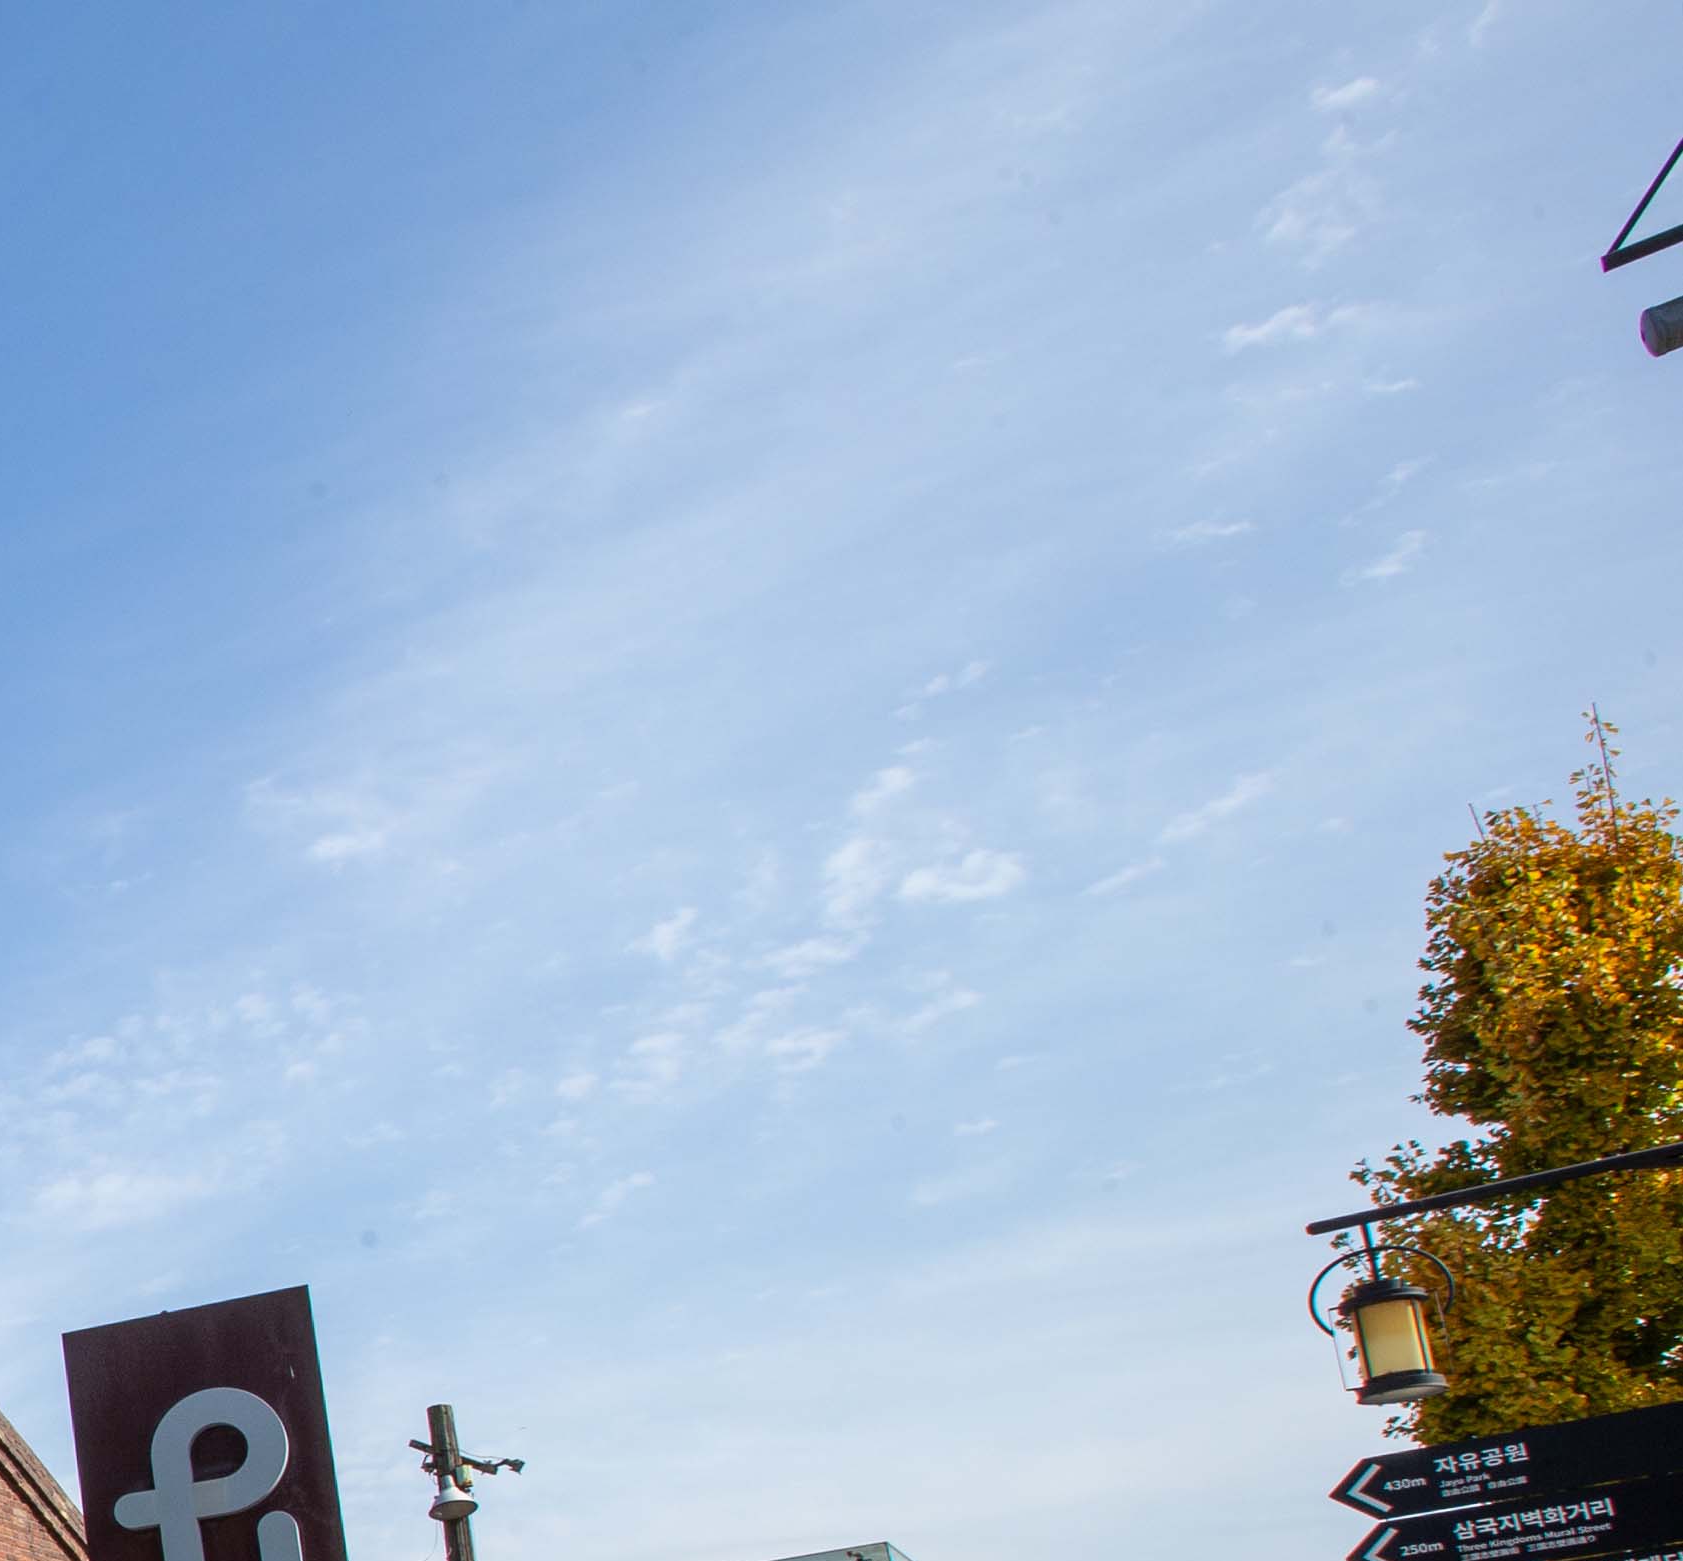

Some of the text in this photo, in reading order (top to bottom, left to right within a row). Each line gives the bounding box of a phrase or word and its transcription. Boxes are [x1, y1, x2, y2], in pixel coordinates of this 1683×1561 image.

[1434, 1442, 1529, 1473] 자유공원
[1383, 1476, 1427, 1491] 430m
[1466, 1472, 1491, 1483] Park
[1453, 1498, 1616, 1540] 삼국지벽화거리
[1400, 1541, 1444, 1556] 250m
[1457, 1542, 1488, 1553] Three
[1489, 1533, 1543, 1549] Kingdoms
[1544, 1527, 1575, 1538] Mural
[1577, 1522, 1612, 1534] Street
